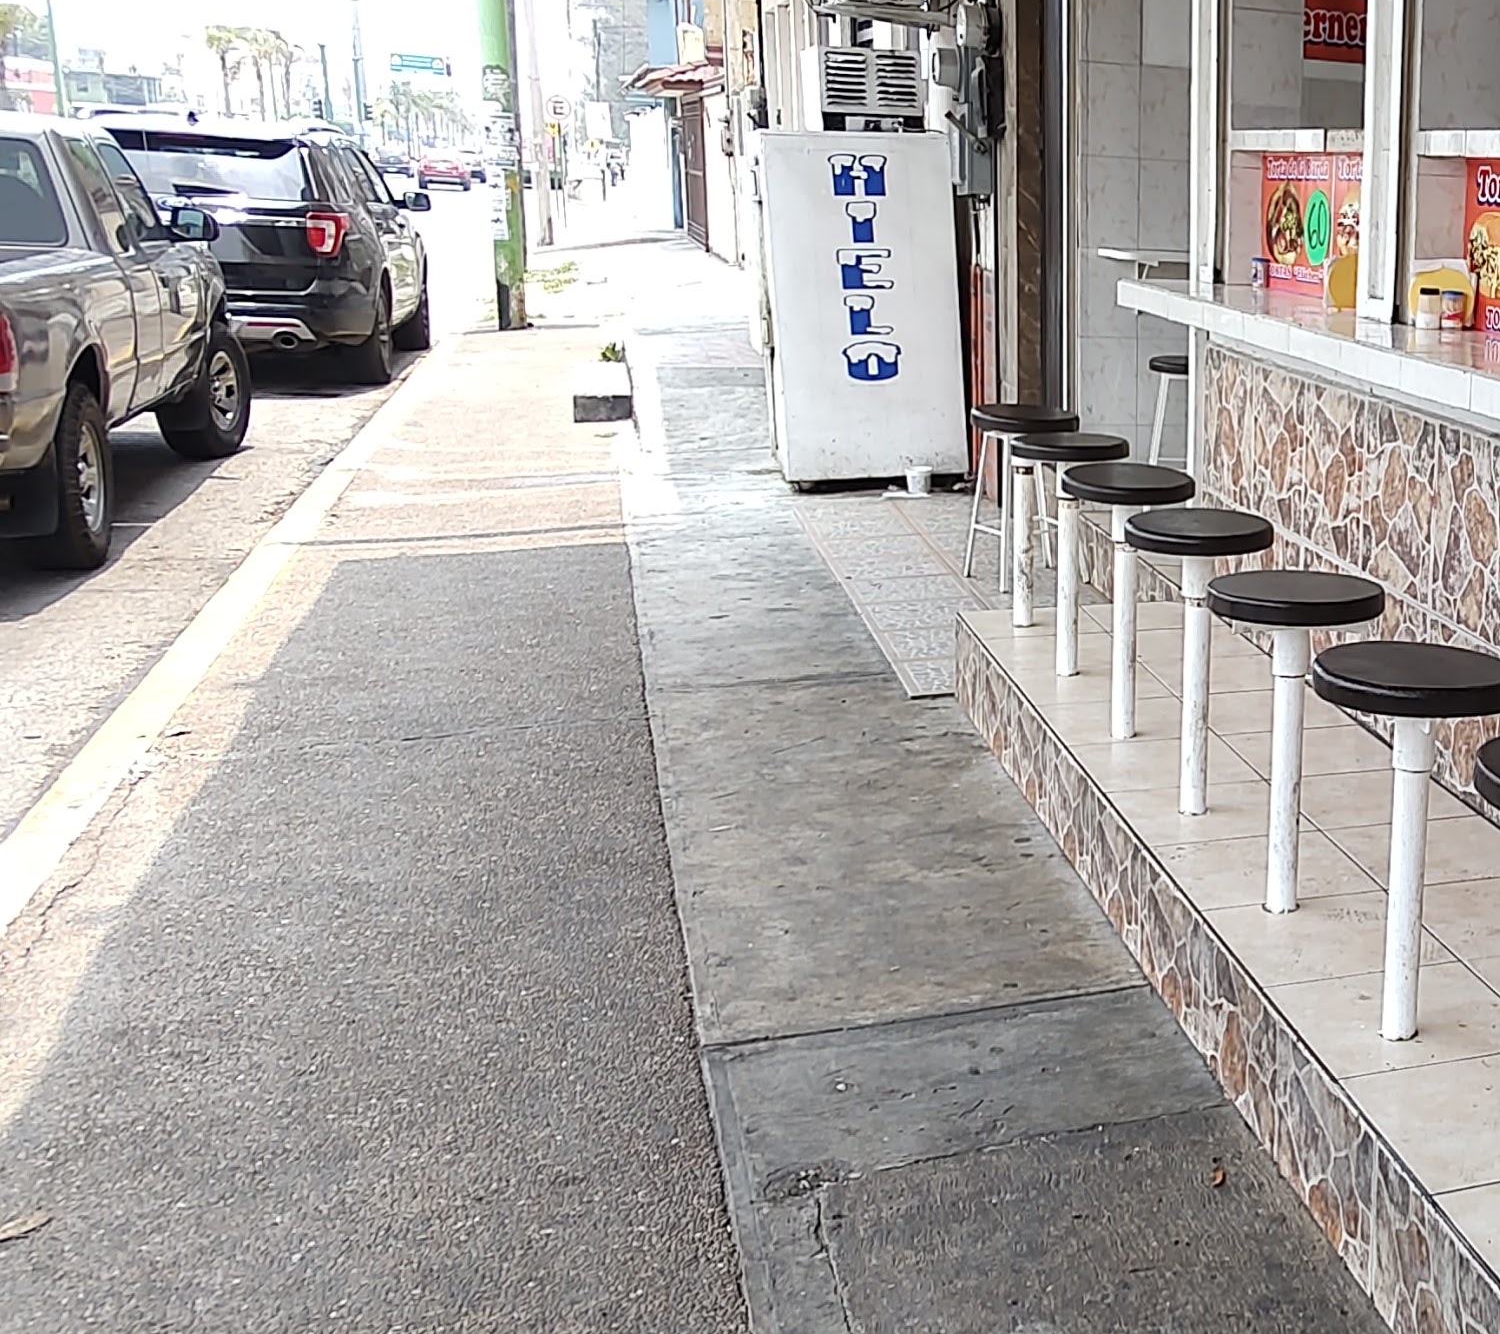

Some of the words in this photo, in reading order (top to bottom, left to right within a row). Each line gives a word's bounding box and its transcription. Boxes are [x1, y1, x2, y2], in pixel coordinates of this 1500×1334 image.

[1339, 155, 1363, 180] Tort
[1308, 200, 1328, 250] 60
[828, 154, 901, 381] HIELO
